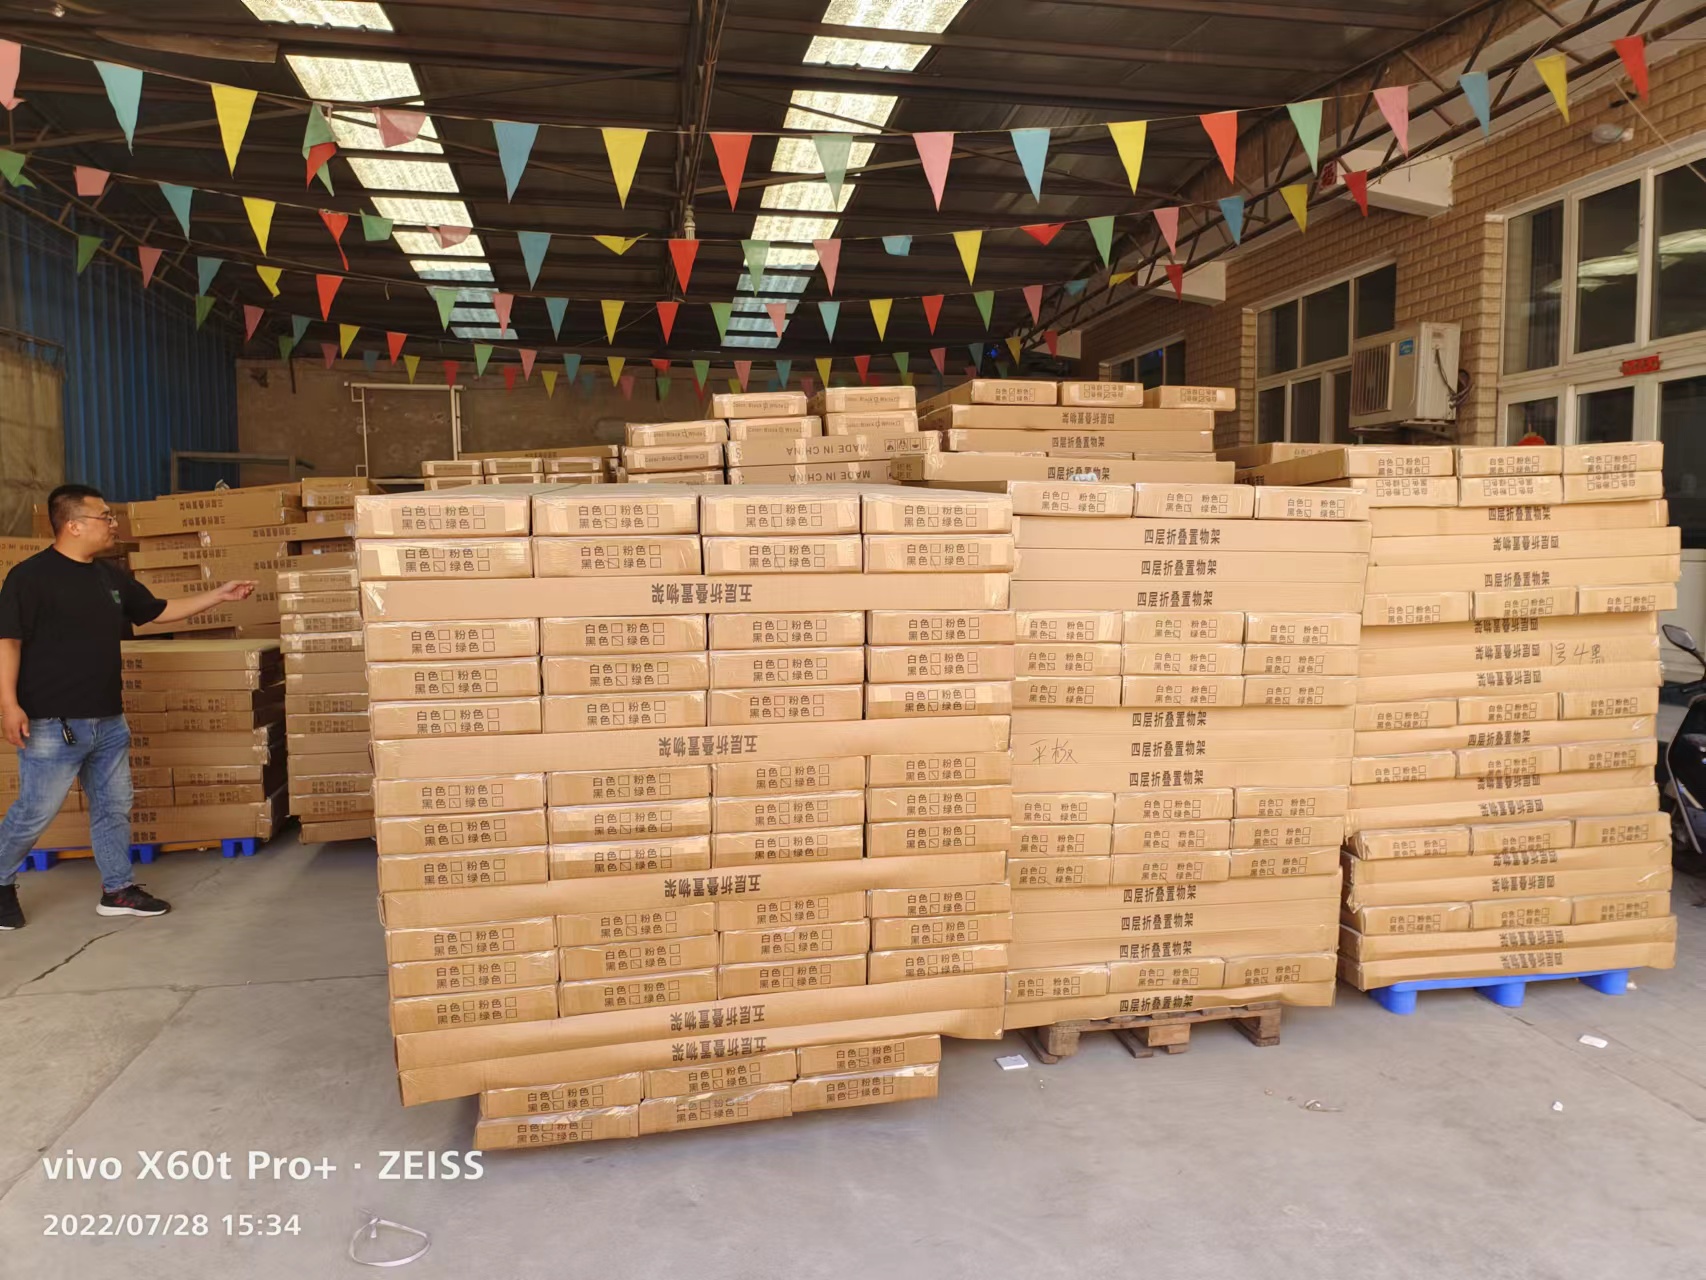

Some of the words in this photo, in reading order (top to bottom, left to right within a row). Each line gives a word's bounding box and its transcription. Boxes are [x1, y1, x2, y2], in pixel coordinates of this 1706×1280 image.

[1052, 436, 1105, 448] 四层折叠置物架
[826, 473, 836, 481] IN
[1488, 506, 1551, 521] 四层折叠置物架
[1144, 529, 1220, 544] 四层折叠置物架
[1493, 535, 1559, 551] 四层折叠置物架
[1141, 560, 1217, 576] 四层折叠置物架
[1484, 572, 1550, 586] 四层折叠置物架
[652, 583, 752, 604] 五层折叠置物架
[1137, 590, 1213, 607] 四层折叠置物架
[1132, 711, 1207, 727] 四层折叠置物架
[658, 735, 758, 758] 五层折叠置物架
[1468, 730, 1531, 746] 四层折叠置物架
[1131, 740, 1206, 757] 四层折叠置物架
[1129, 769, 1204, 787] 四层折叠置物架
[664, 874, 761, 898] 五层折叠置物架
[1123, 885, 1196, 903] 四层折叠置物架
[1121, 912, 1194, 931] 四层折叠置物架
[1120, 941, 1192, 959] 四层折叠置物架
[1120, 995, 1194, 1012] 四层折叠置物架
[671, 1005, 765, 1031] 五层折叠置物架
[672, 1036, 767, 1062] 五层折叠置物架
